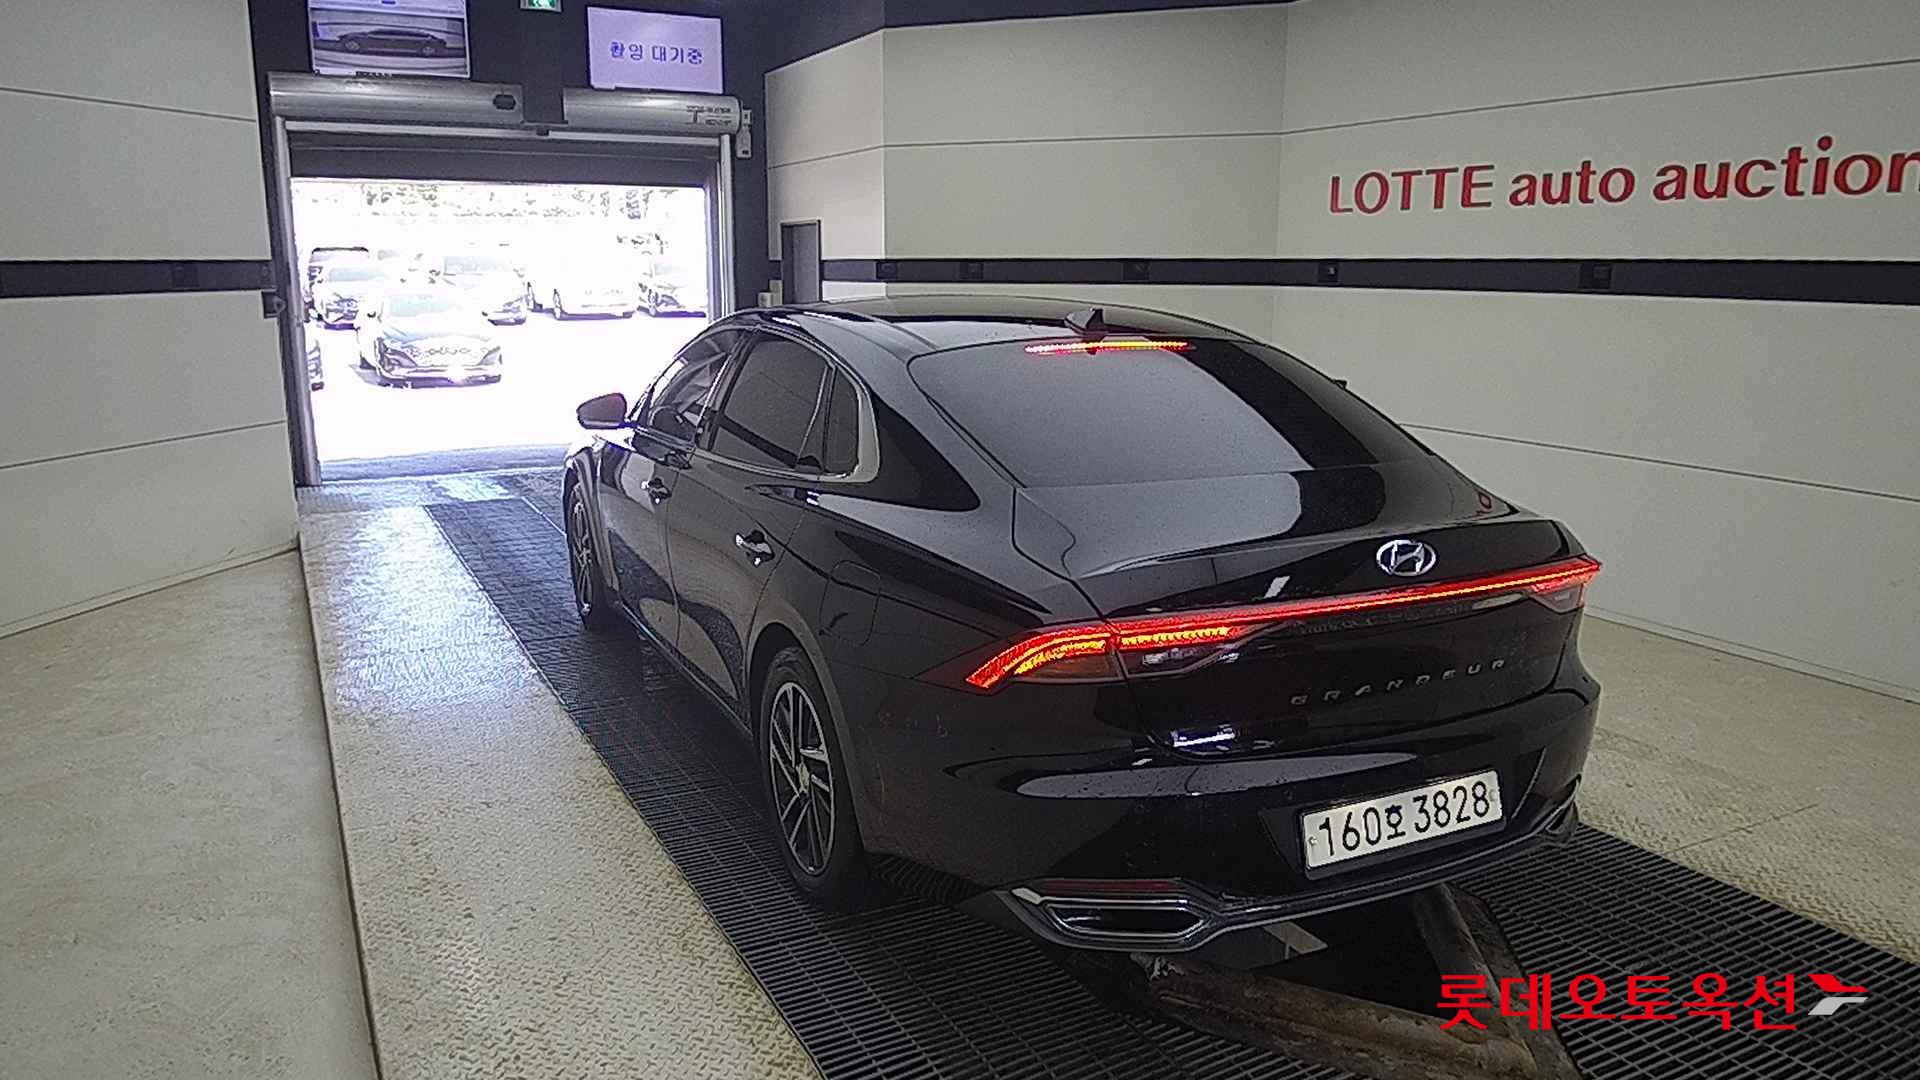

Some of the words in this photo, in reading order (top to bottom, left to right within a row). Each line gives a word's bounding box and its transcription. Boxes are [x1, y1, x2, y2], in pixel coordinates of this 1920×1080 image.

[652, 45, 702, 65] 대기중
[1330, 164, 1495, 214] LOTTE
[1508, 160, 1635, 206] auto
[1652, 136, 1920, 200] auction
[1290, 659, 1505, 705] GRANDEUR
